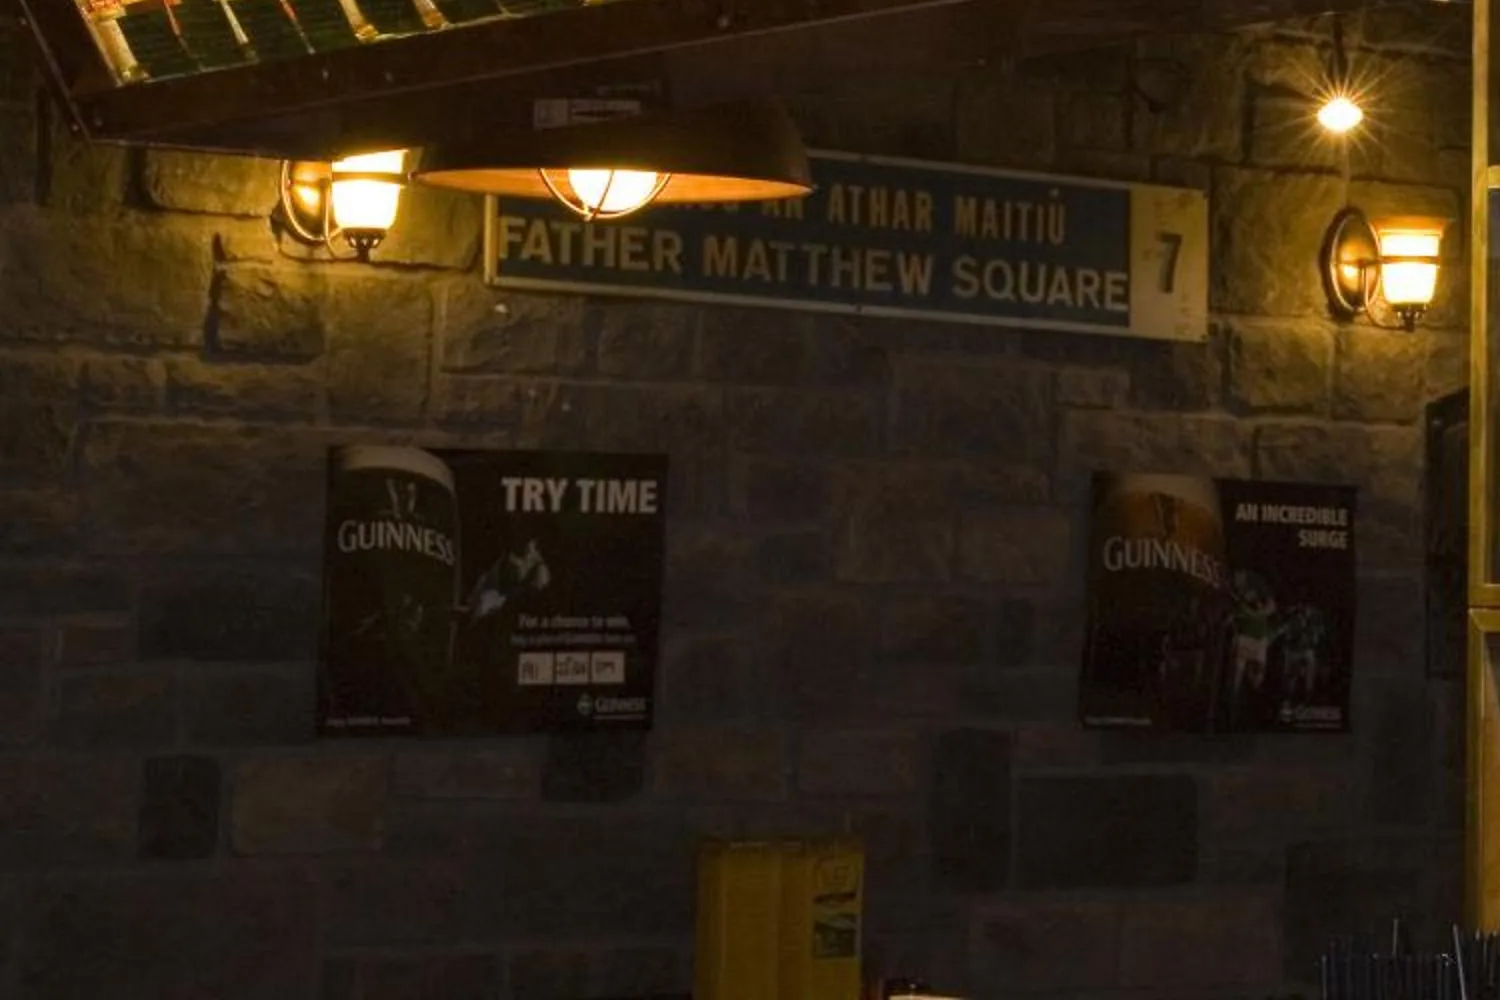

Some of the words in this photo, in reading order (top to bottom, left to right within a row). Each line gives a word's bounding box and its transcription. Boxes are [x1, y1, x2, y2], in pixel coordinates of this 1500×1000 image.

[828, 182, 934, 234] ATHAR
[954, 186, 1067, 246] MAITIÚ
[499, 214, 684, 275] FATHER
[704, 234, 934, 297] MATTHEW
[951, 253, 1130, 313] SQUARE
[1156, 231, 1183, 294] 7
[501, 476, 568, 513] TRY
[575, 479, 658, 515] TIME
[1235, 503, 1258, 522] AN
[1261, 504, 1350, 527] INCREDIBLE
[337, 518, 456, 567] GUINNESS
[1297, 527, 1349, 550] SURGE
